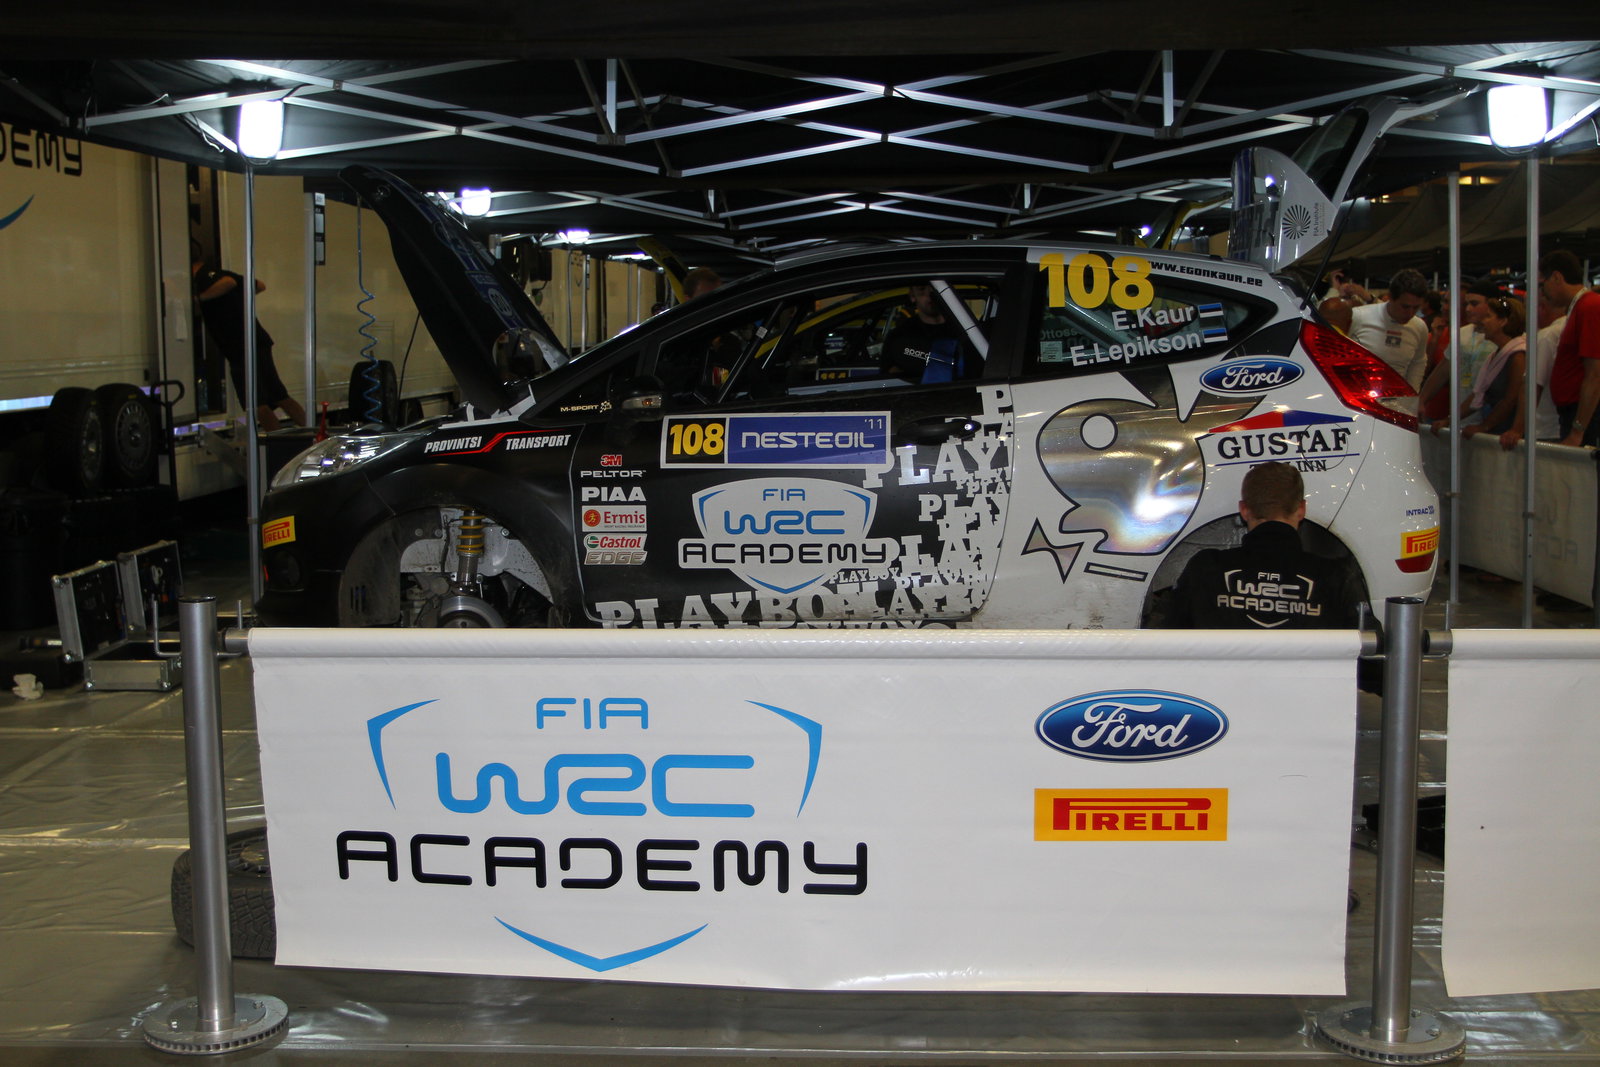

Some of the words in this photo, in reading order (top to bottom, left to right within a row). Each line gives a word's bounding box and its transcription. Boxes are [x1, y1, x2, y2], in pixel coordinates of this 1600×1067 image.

[1039, 253, 1154, 311] 108
[1111, 305, 1195, 332] E.Kaur
[1070, 332, 1201, 367] E.Lepikson
[1221, 362, 1284, 389] Ford
[560, 404, 599, 413] M-SPORT
[424, 436, 483, 453] PROVINTSI
[506, 435, 571, 451] TRANSPORT
[669, 423, 725, 456] 108
[1217, 427, 1351, 459] GUSTAF
[601, 454, 622, 467] 3M
[581, 486, 647, 502] PIAA
[762, 488, 806, 502] FIA
[604, 510, 645, 524] Ermis
[724, 509, 846, 535] WRC
[600, 536, 642, 549] Castrol
[682, 542, 887, 564] ACADEMY
[586, 552, 646, 564] EDGE
[1258, 571, 1281, 582] FIA
[1236, 579, 1300, 599] WRC
[1217, 595, 1321, 616] ACADEMY
[536, 698, 649, 729] FIA
[1071, 701, 1192, 748] Ford
[435, 752, 755, 818] WRC
[1053, 797, 1211, 830] PIRELLI
[337, 830, 867, 896] ACADEMY
